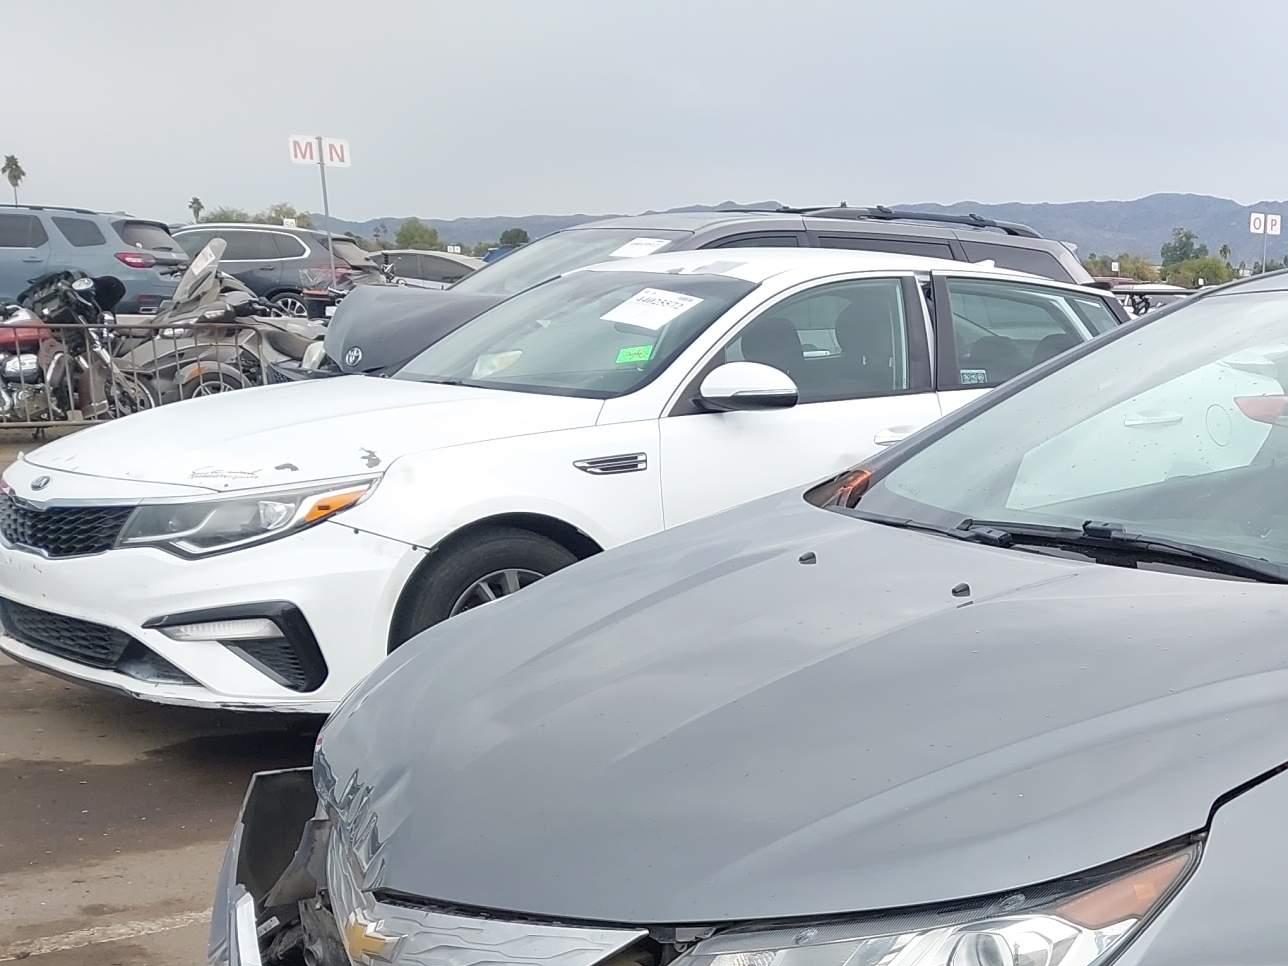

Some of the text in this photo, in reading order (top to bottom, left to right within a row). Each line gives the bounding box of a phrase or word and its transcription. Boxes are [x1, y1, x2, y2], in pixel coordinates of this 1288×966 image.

[293, 140, 314, 161] M
[328, 143, 345, 163] N
[1270, 218, 1278, 231] P
